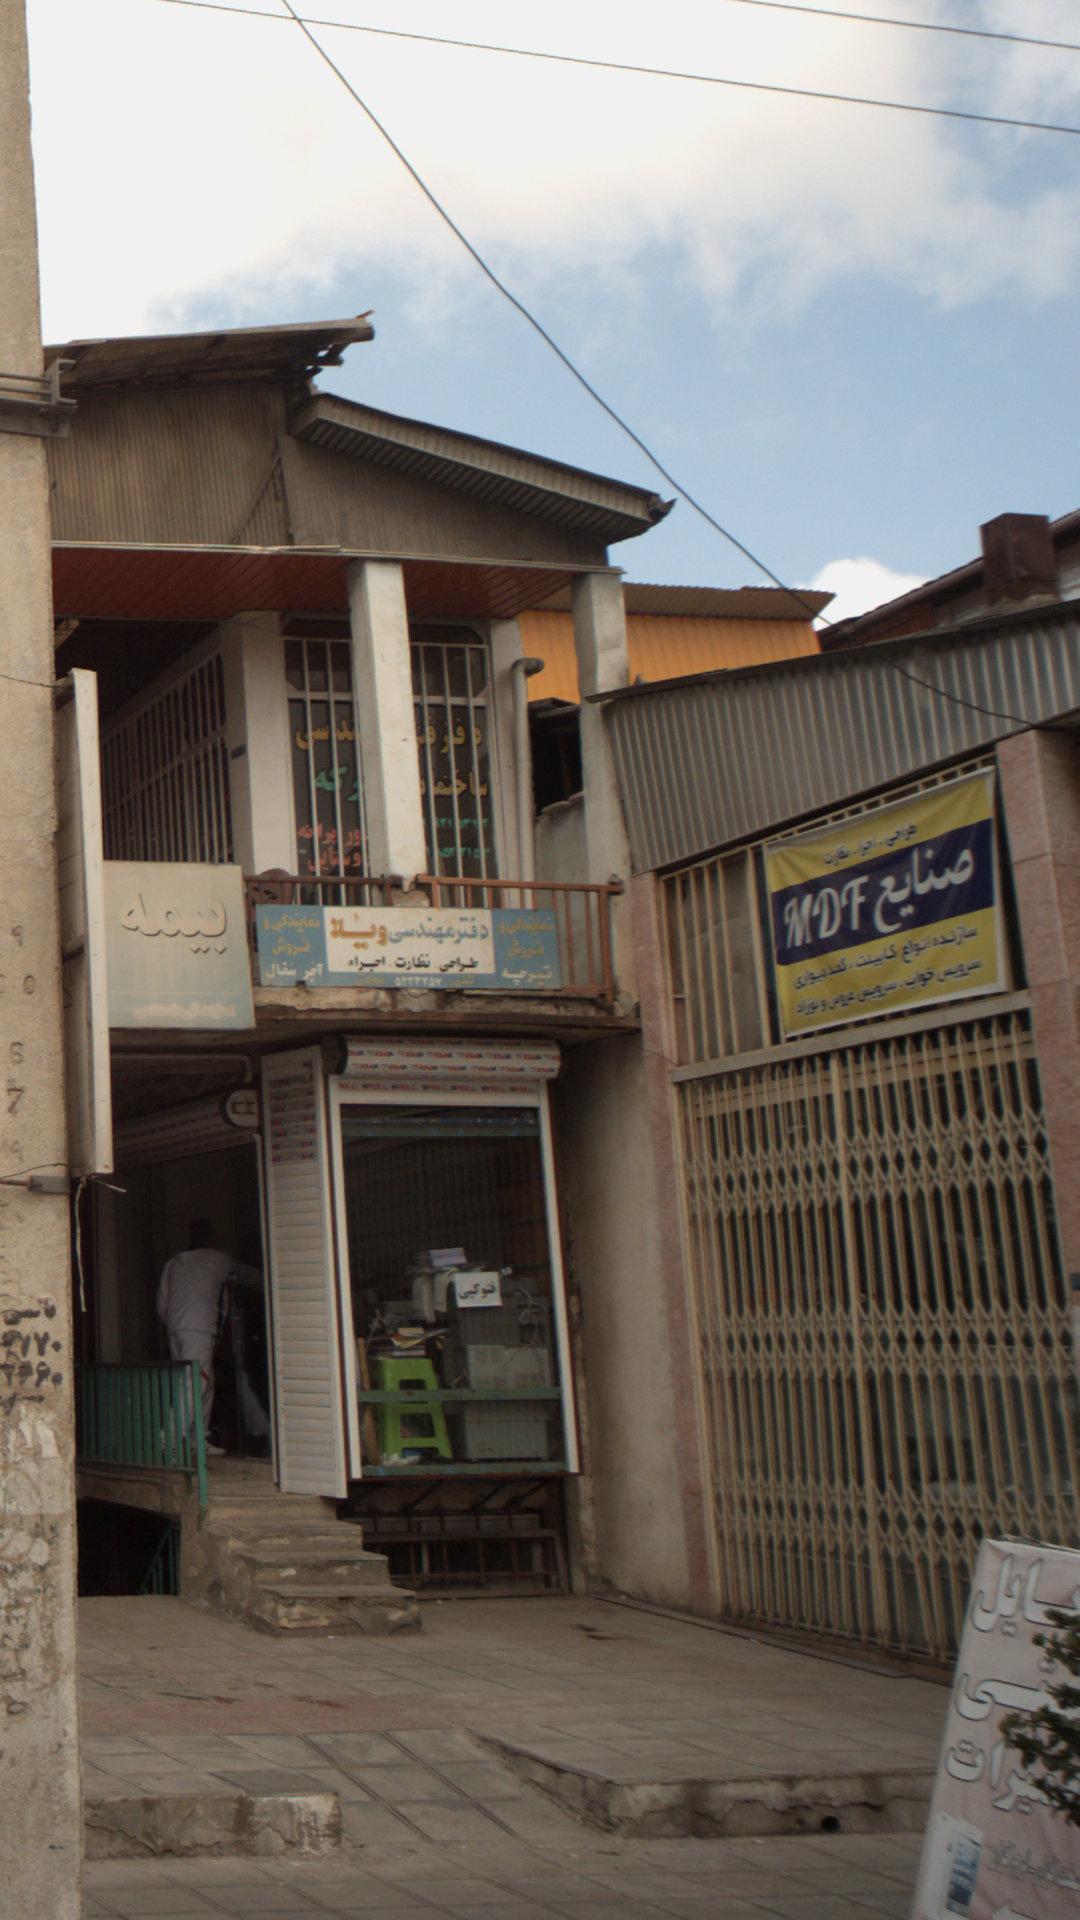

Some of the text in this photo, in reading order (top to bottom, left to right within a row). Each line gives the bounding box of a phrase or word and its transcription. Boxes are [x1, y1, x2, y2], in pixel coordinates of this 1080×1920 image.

[784, 847, 974, 949] صنایع MDF
[330, 913, 489, 949] دفتر مهندسی ویلا
[272, 936, 310, 956] فروش
[856, 944, 898, 968] کابینت
[901, 935, 932, 964] انواع
[264, 961, 325, 983] آجر سفال
[394, 953, 431, 972] نظارت
[439, 956, 478, 973] طراحی
[937, 960, 982, 983] سرویس
[502, 965, 554, 987] تیرچه
[905, 968, 936, 990] خواب
[858, 983, 898, 1003] سرویس
